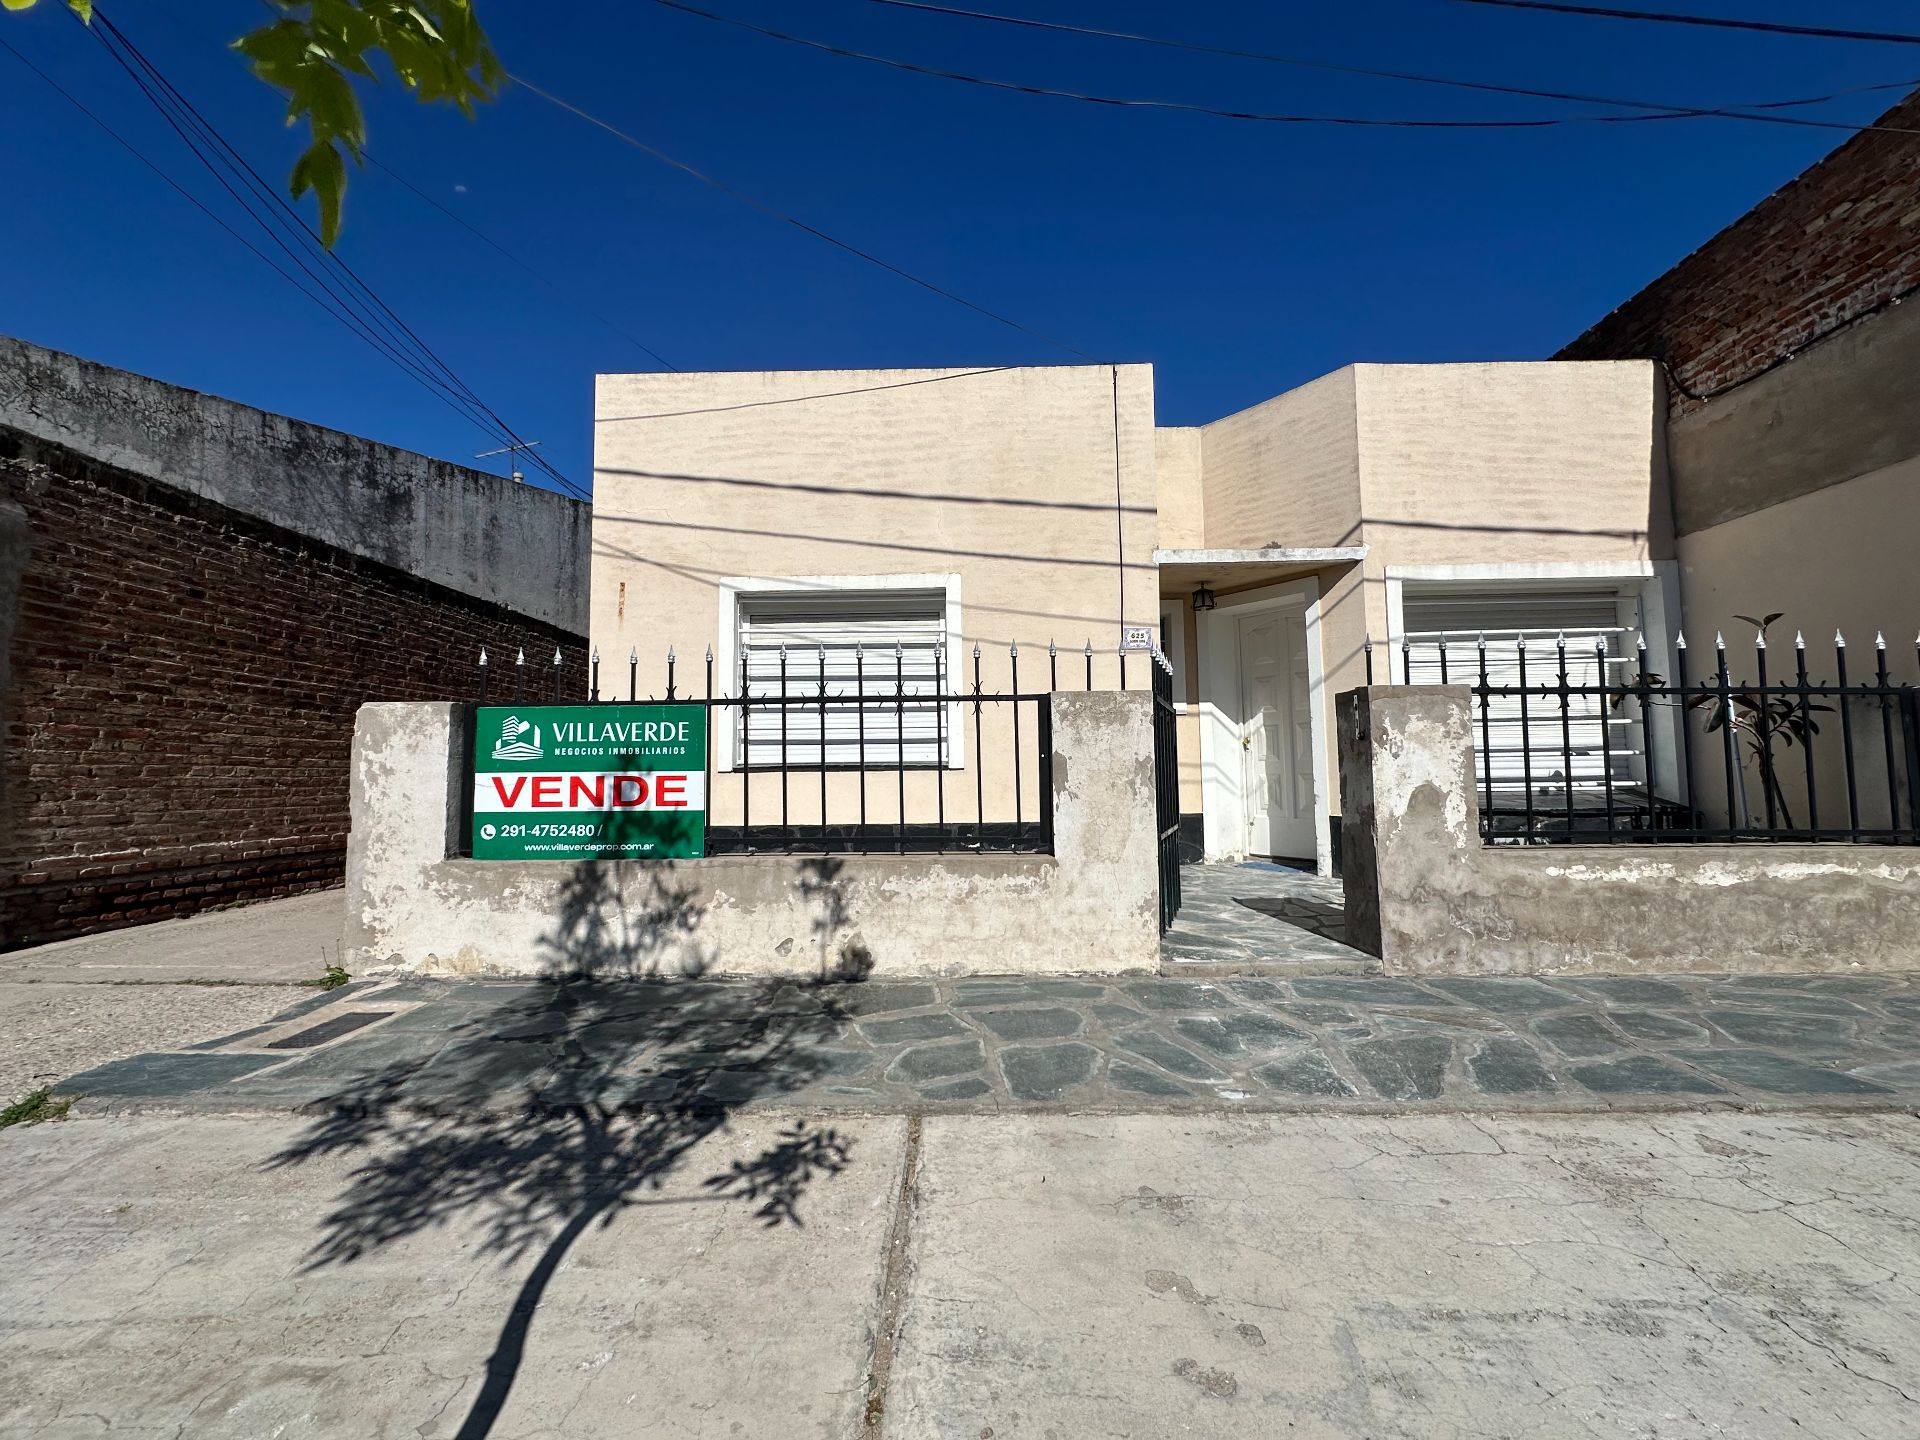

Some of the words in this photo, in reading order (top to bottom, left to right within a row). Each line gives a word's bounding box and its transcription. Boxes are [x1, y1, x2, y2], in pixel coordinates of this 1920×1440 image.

[552, 721, 689, 742] VILLAVERDE
[555, 747, 604, 756] NEGOCIOS
[608, 746, 686, 755] INMOBILIARIOS
[492, 775, 688, 808] VENDE
[500, 824, 595, 837] 291-4752480
[524, 843, 655, 853] www.villaverdeprop.com.ar
